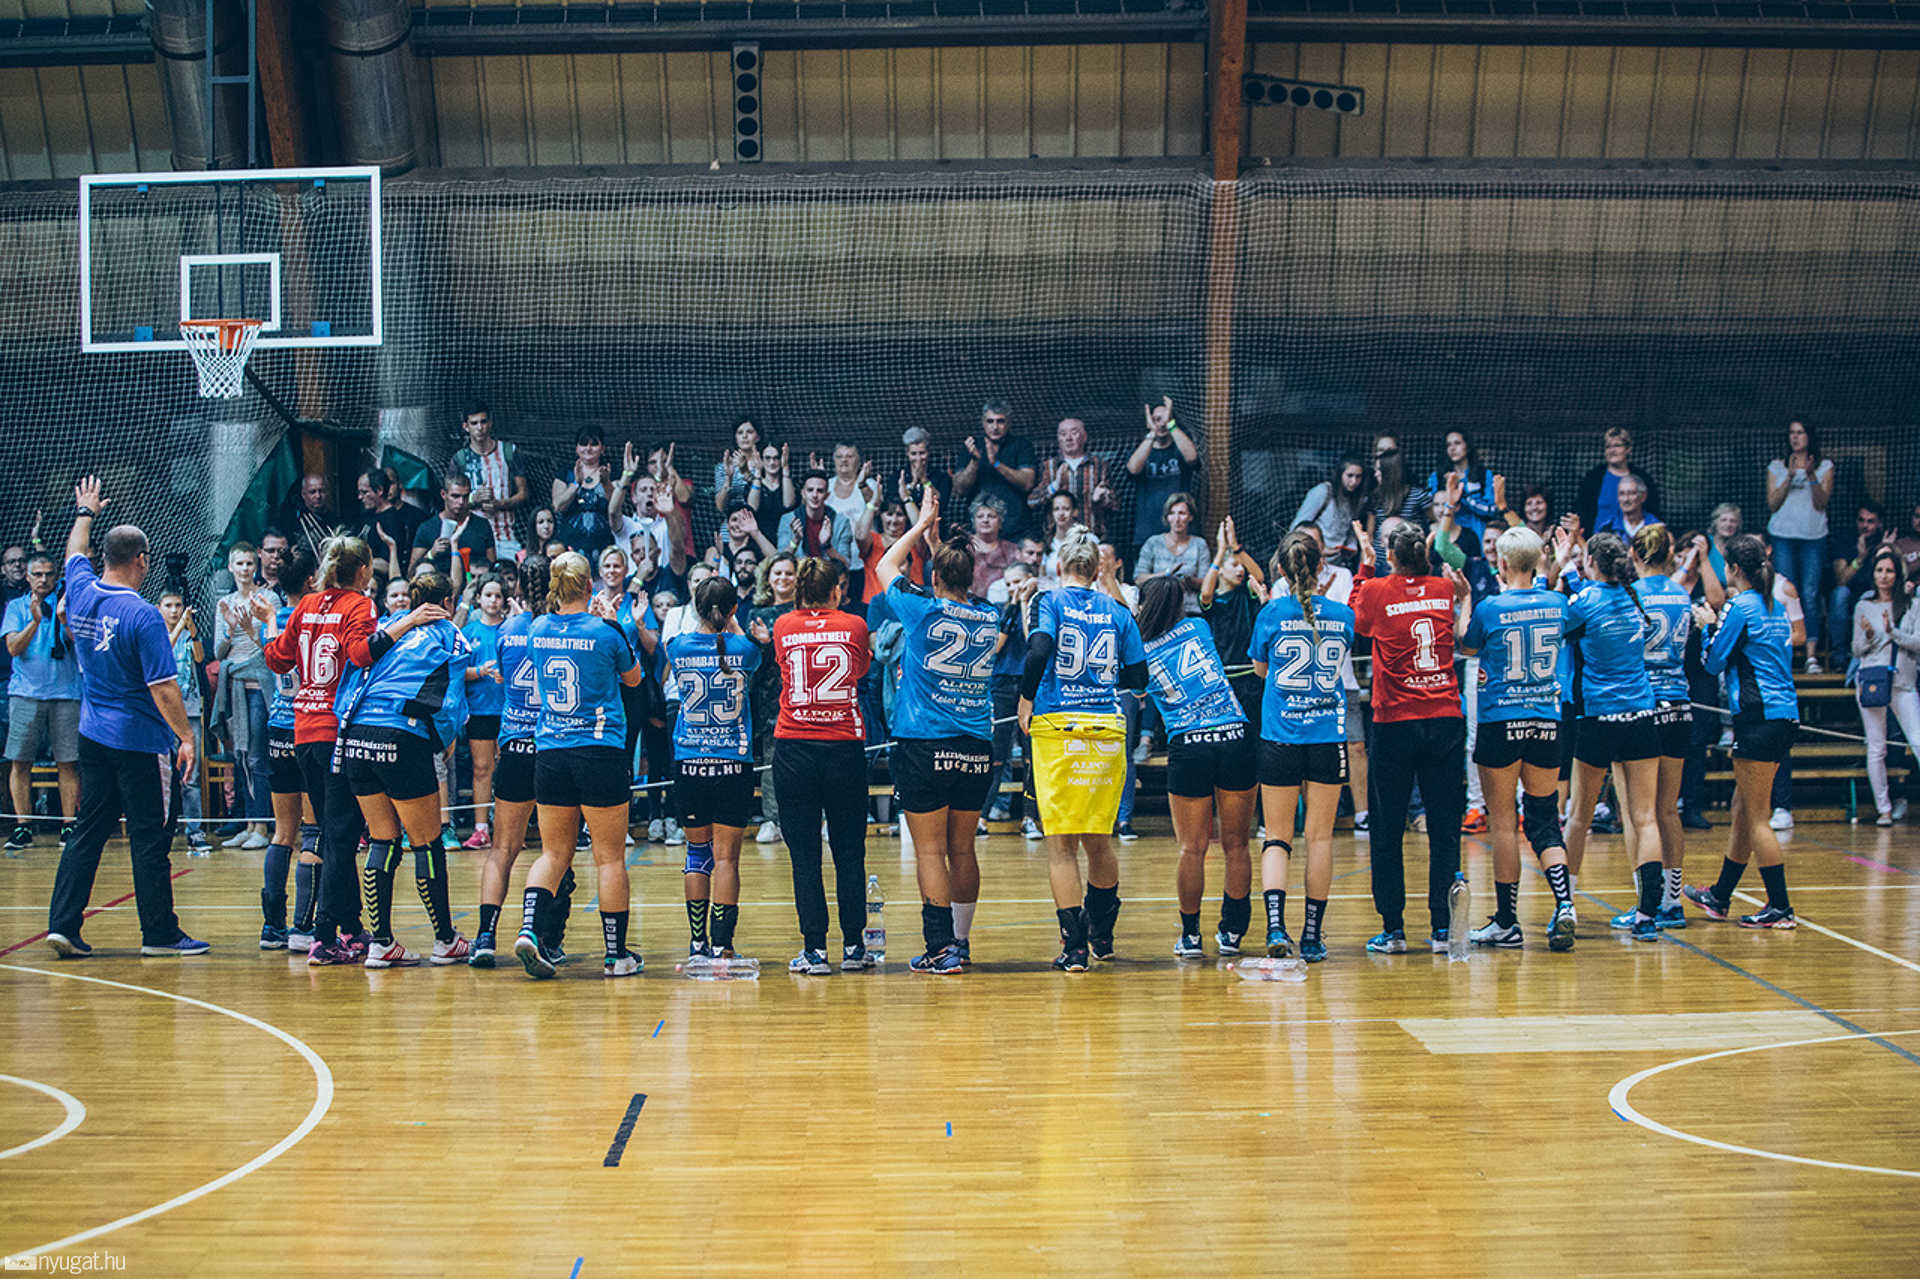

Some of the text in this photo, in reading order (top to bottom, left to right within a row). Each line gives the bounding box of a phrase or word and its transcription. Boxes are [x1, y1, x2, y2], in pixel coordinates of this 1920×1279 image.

[298, 630, 339, 688] 16
[924, 617, 1000, 680] 22
[1055, 622, 1119, 685] 94
[1274, 635, 1347, 693] 29
[1410, 618, 1441, 672] 1
[1502, 623, 1562, 682] 15
[1643, 608, 1691, 663] 24
[542, 655, 581, 715] 3
[675, 668, 748, 725] 23
[786, 643, 853, 705] 12
[1147, 635, 1222, 704] 14
[681, 763, 743, 777] LUCE.HU
